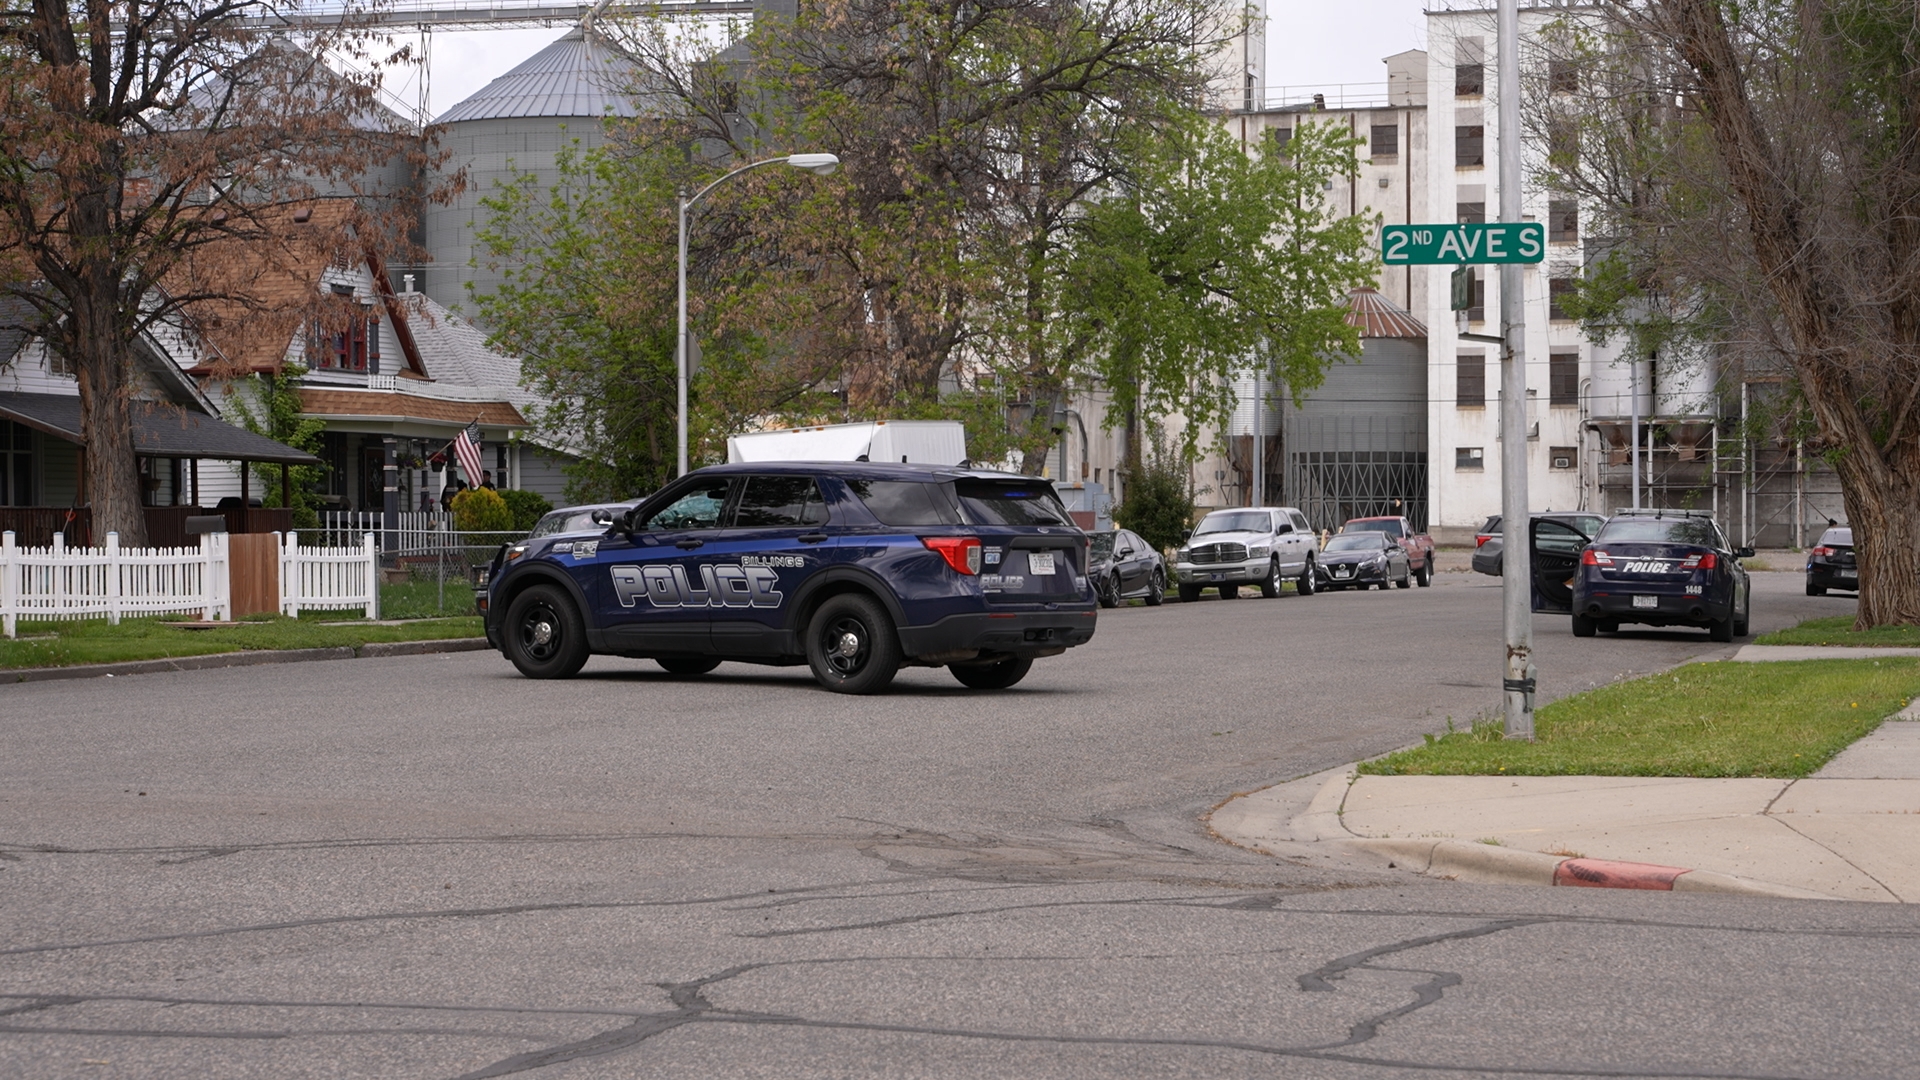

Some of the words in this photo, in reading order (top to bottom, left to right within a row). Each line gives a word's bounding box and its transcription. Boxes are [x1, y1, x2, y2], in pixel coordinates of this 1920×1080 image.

[1386, 230, 1433, 260] 2ND
[1437, 229, 1508, 259] AVE
[1518, 227, 1541, 257] S
[741, 555, 805, 568] BILLINGS
[1623, 562, 1671, 574] POLICE
[610, 563, 784, 609] POLICE
[981, 576, 1024, 588] POLICE
[1685, 585, 1702, 594] 1448
